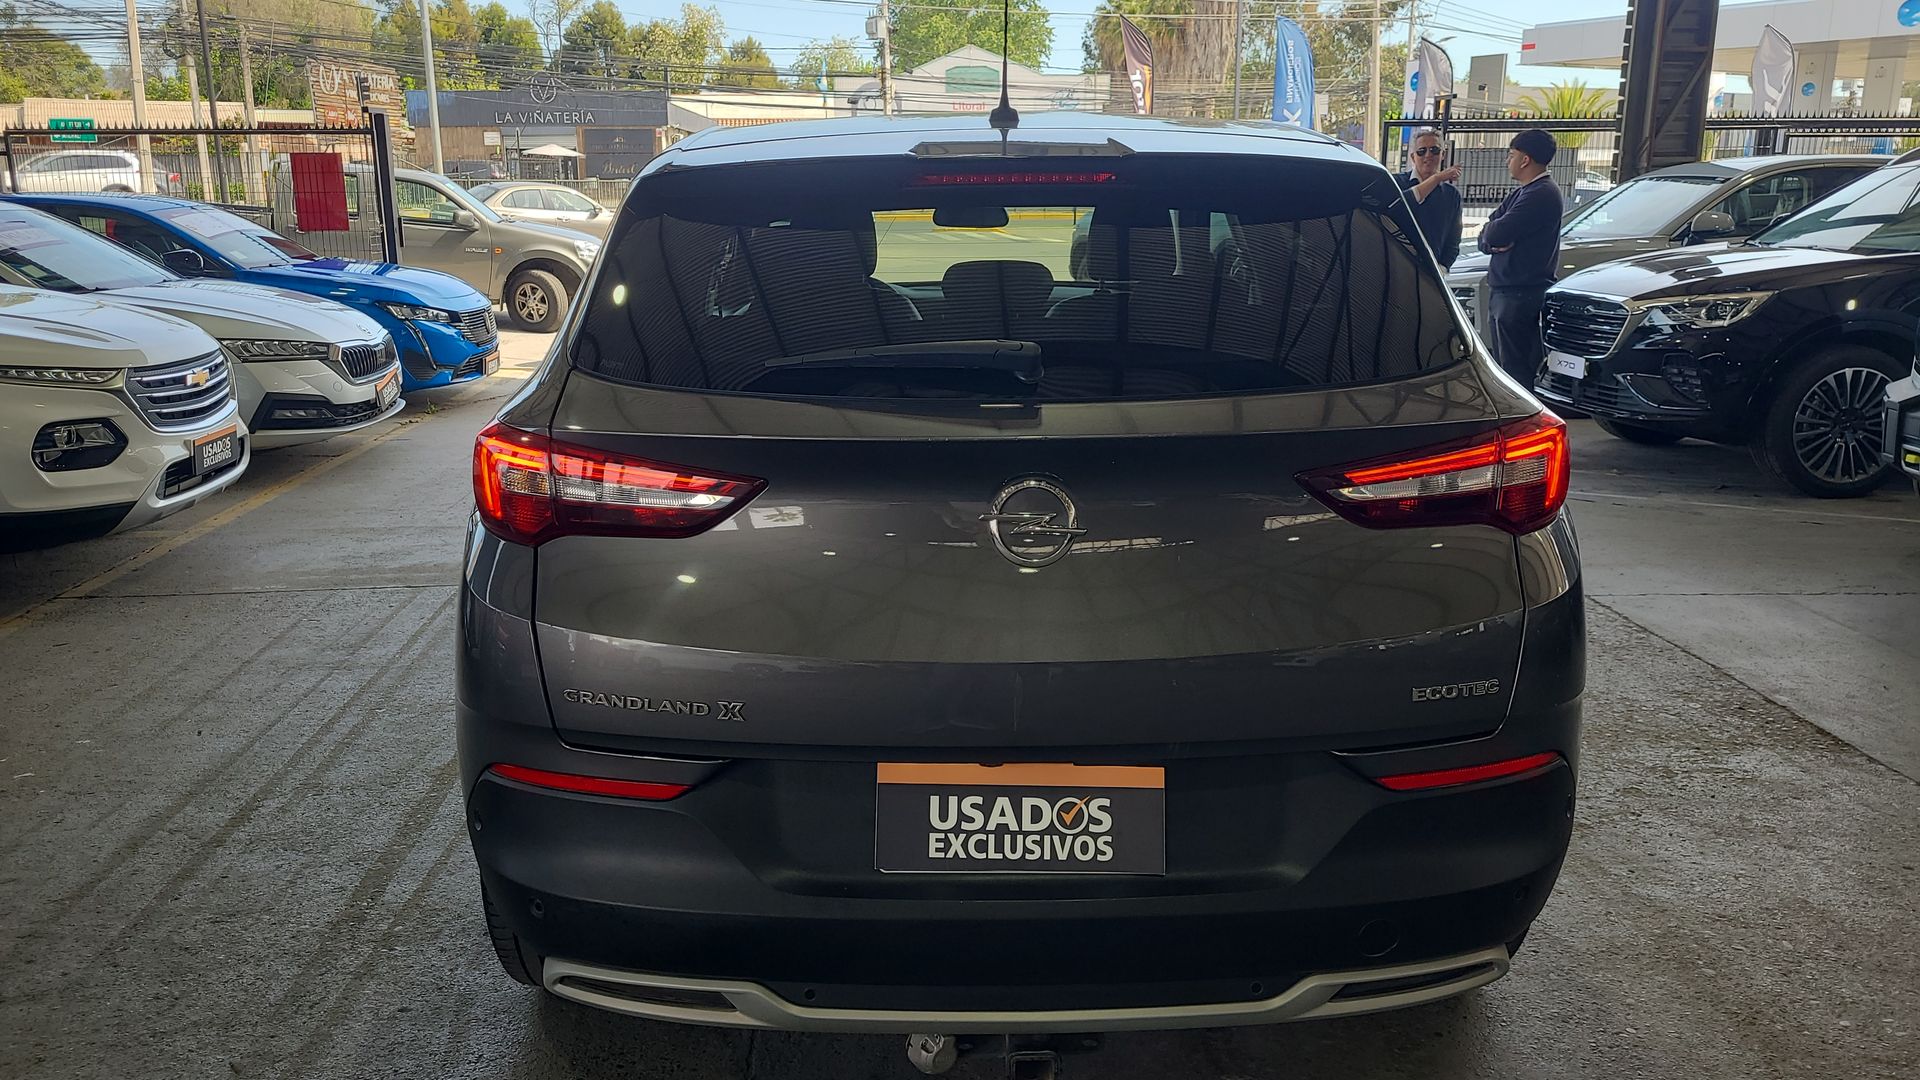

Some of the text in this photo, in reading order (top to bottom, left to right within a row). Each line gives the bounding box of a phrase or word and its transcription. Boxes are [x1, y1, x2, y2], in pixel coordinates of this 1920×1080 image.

[495, 109, 595, 124] LA VIÑATERÍA
[952, 102, 985, 111] Litoral
[1557, 360, 1576, 370] X70
[203, 436, 231, 458] USADOS
[203, 448, 232, 468] EXCLUSIVOS
[1412, 679, 1500, 702] ECOTEC
[563, 688, 745, 722] GRANDLAND X
[929, 795, 1114, 834] USADOS
[928, 833, 1114, 862] EXCLUSIVOS
